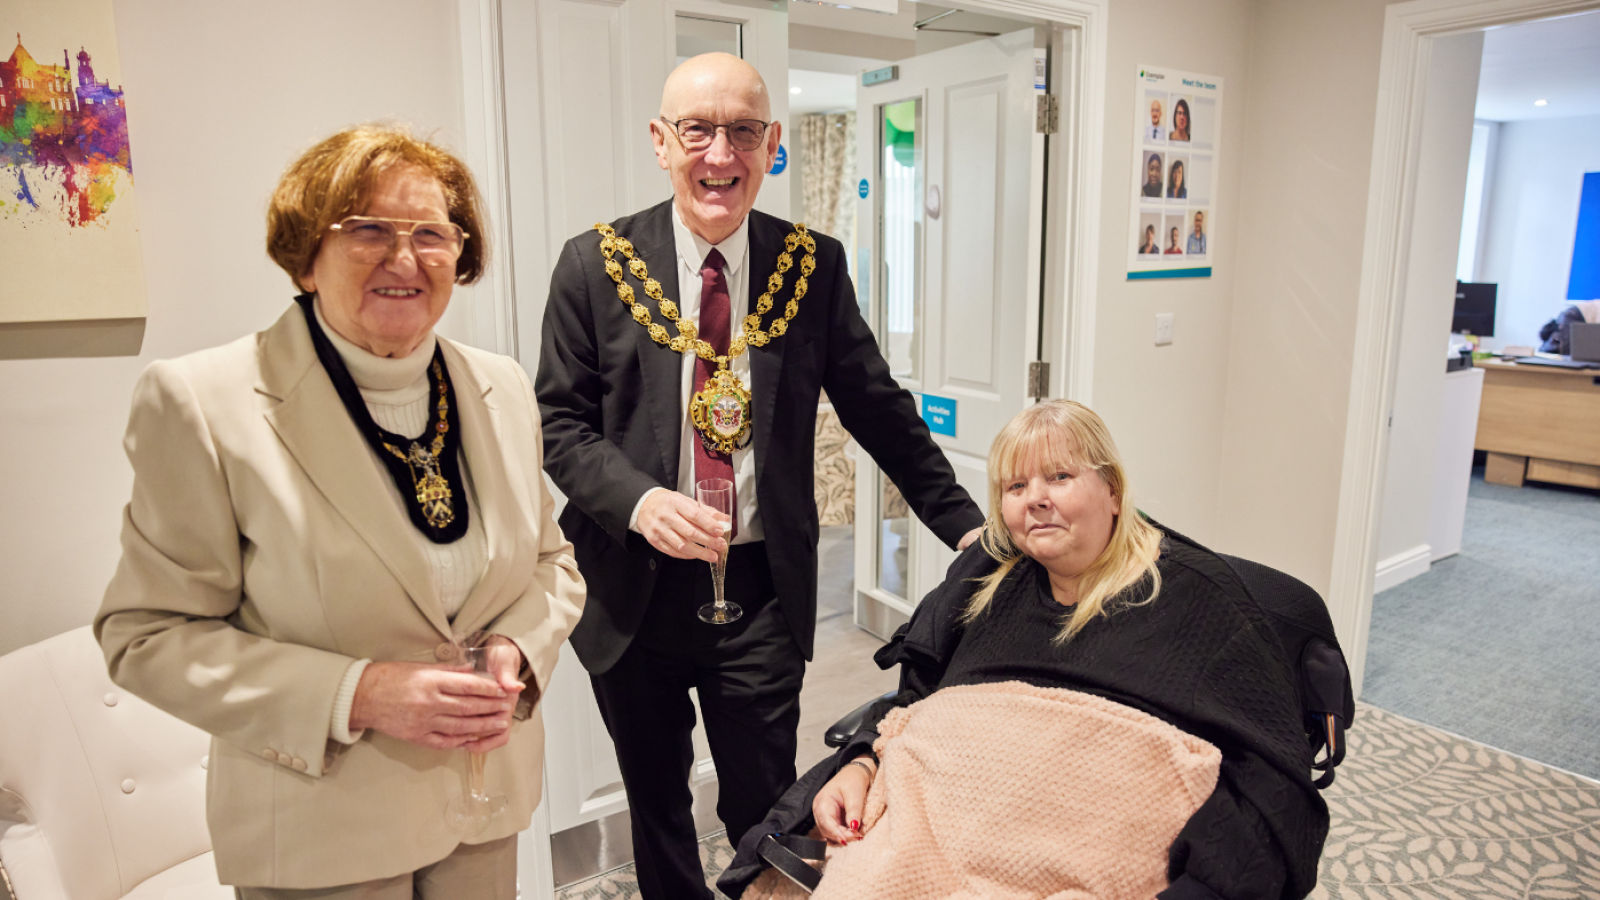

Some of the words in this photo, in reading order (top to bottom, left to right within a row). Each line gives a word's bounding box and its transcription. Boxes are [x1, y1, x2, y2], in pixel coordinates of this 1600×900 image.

[1182, 78, 1194, 87] Meet
[1204, 82, 1216, 90] team
[927, 404, 950, 416] Activities
